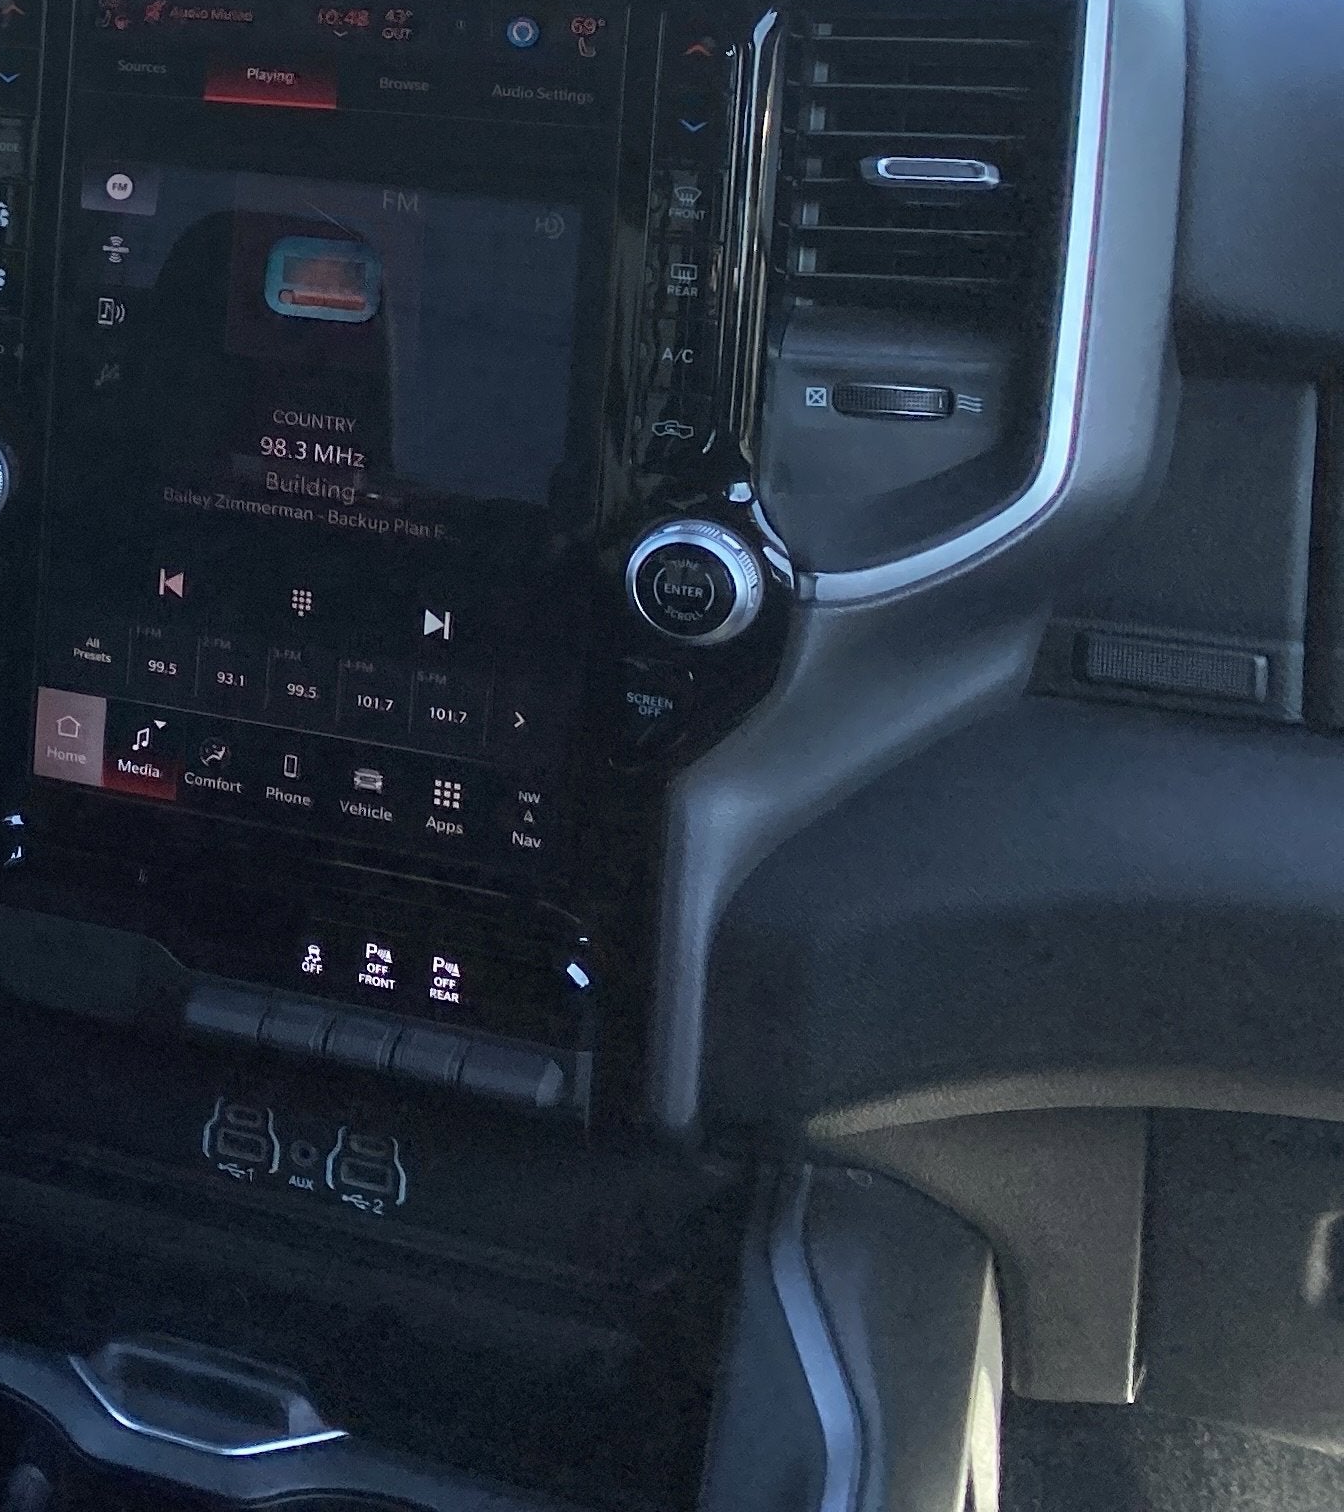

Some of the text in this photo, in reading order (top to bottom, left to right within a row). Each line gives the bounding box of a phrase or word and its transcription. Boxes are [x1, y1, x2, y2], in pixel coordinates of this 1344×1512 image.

[381, 27, 413, 40] OUT
[118, 58, 167, 75] Sources
[246, 65, 296, 86] Playing
[379, 76, 430, 93] Browse
[491, 83, 594, 105] Audio Settings
[112, 181, 128, 192] FM
[381, 190, 420, 213] FM
[668, 208, 706, 221] FRONT
[666, 284, 699, 298] REAR
[662, 346, 695, 364] A/C
[271, 408, 358, 433] COUNTRY
[260, 435, 366, 469] 98.3 MHz
[264, 470, 357, 506] Building
[163, 486, 212, 509] Bailey
[214, 492, 314, 522] Zimmerman
[327, 508, 390, 534] Backup
[393, 517, 430, 538] Plan
[663, 582, 705, 599] ENTER
[663, 604, 705, 622] SCROLL
[85, 636, 101, 650] All
[73, 646, 113, 665] Presets
[147, 658, 179, 676] 99.5
[215, 670, 247, 688] 93.1
[286, 682, 318, 701] 99.5
[625, 690, 674, 710] SCREEN
[355, 693, 395, 713] 101.7
[637, 704, 663, 718] OFF
[428, 705, 468, 725] 101.7
[46, 745, 88, 766] Home
[116, 757, 162, 779] Media
[183, 770, 244, 795] Comfort
[265, 785, 313, 808] Phone
[517, 789, 543, 805] NW
[338, 798, 395, 823] Vehicle
[424, 814, 465, 837] Apps
[511, 829, 543, 850] Nav
[300, 960, 324, 976] OFF
[366, 962, 391, 976] OFF
[358, 972, 398, 991] FRONT
[433, 976, 458, 991] OFF
[429, 987, 461, 1005] REAR
[287, 1174, 315, 1192] AUX
[372, 1197, 385, 1216] 2
